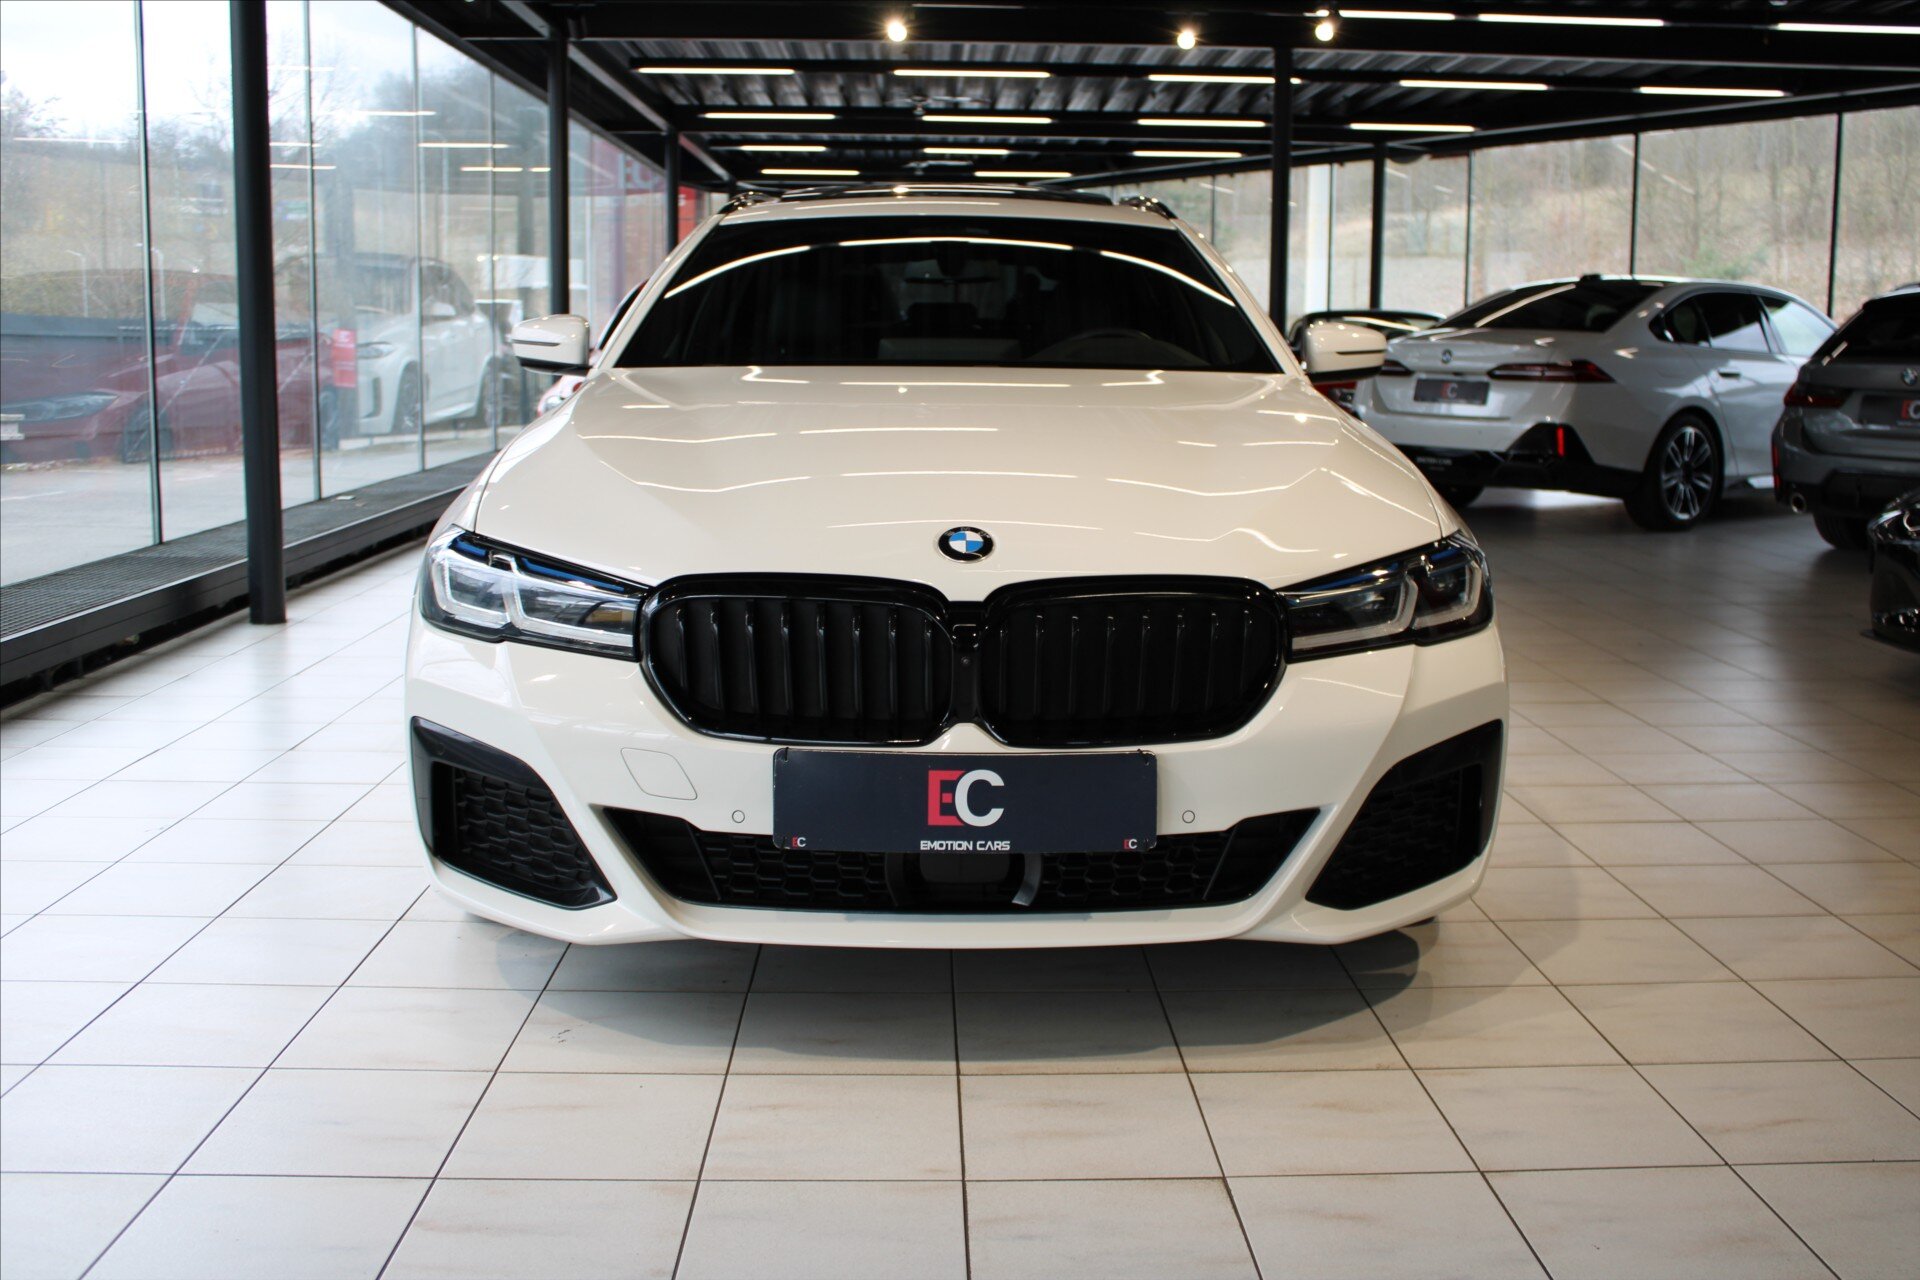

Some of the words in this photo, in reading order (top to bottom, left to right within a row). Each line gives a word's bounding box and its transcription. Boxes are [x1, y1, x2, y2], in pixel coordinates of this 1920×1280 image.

[927, 769, 1005, 827] EC
[792, 836, 806, 848] EC
[920, 840, 972, 851] EMOTION
[976, 840, 1011, 851] CARS
[1123, 838, 1138, 849] EC
